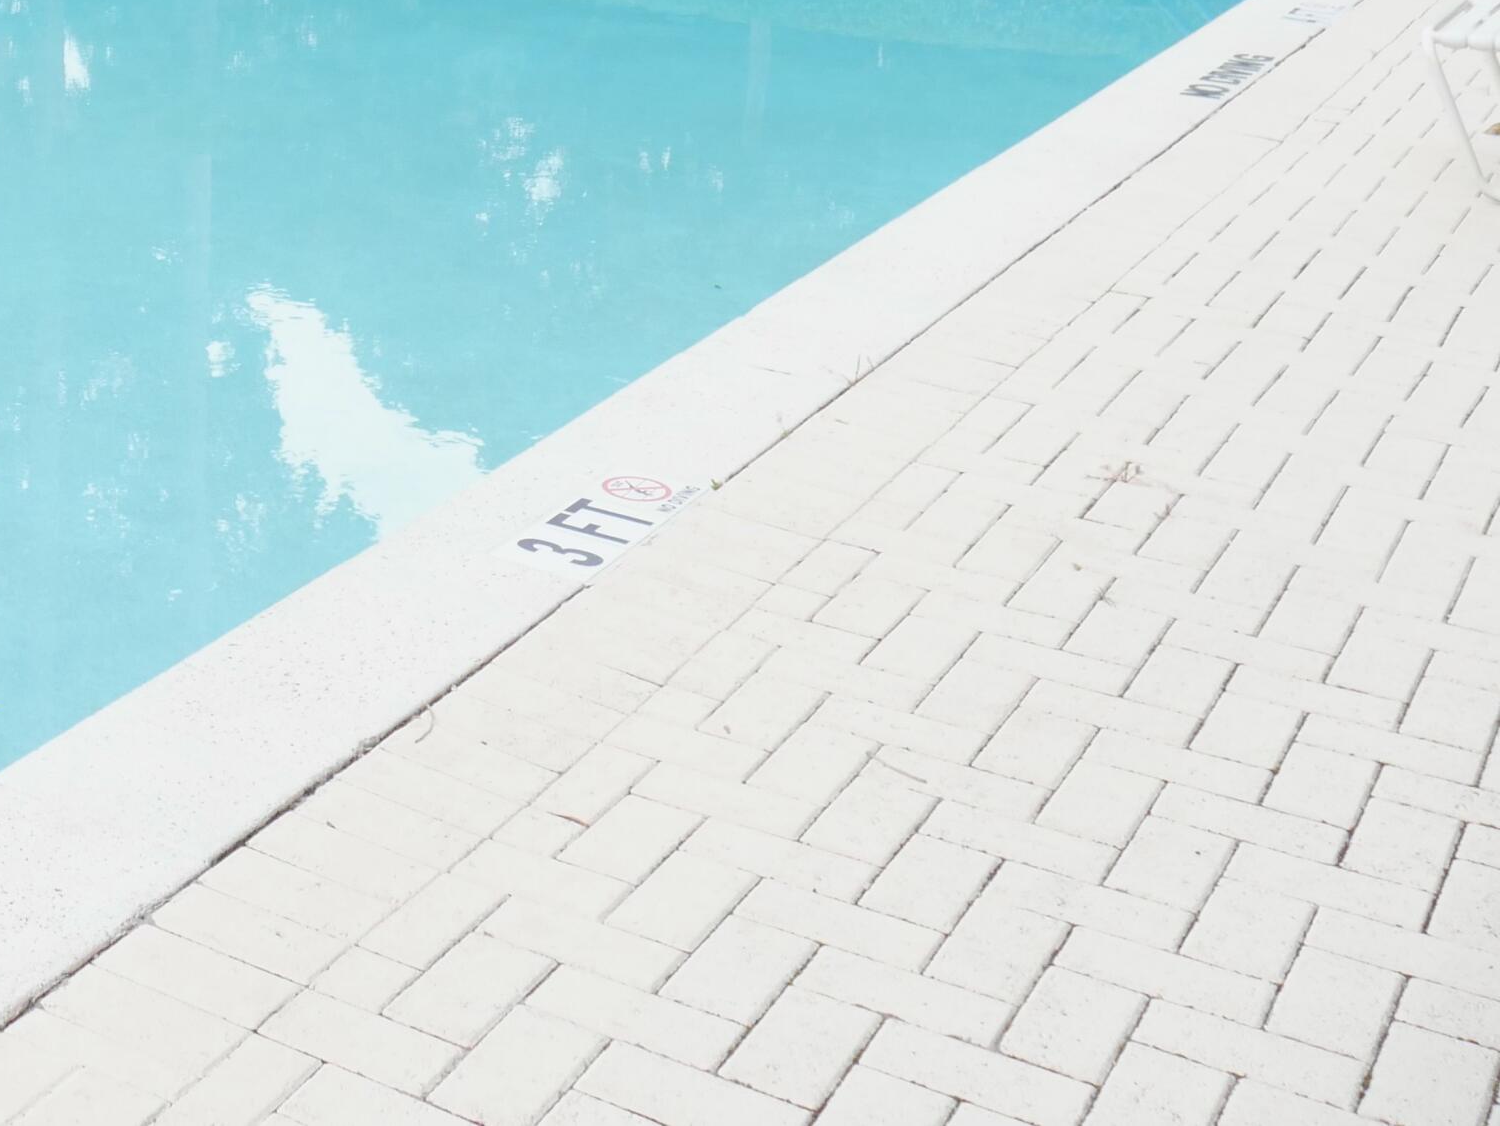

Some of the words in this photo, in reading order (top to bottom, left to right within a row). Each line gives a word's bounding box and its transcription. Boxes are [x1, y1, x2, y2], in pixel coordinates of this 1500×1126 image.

[1180, 84, 1230, 100] NO
[546, 498, 653, 545] FT
[517, 538, 604, 567] 3
